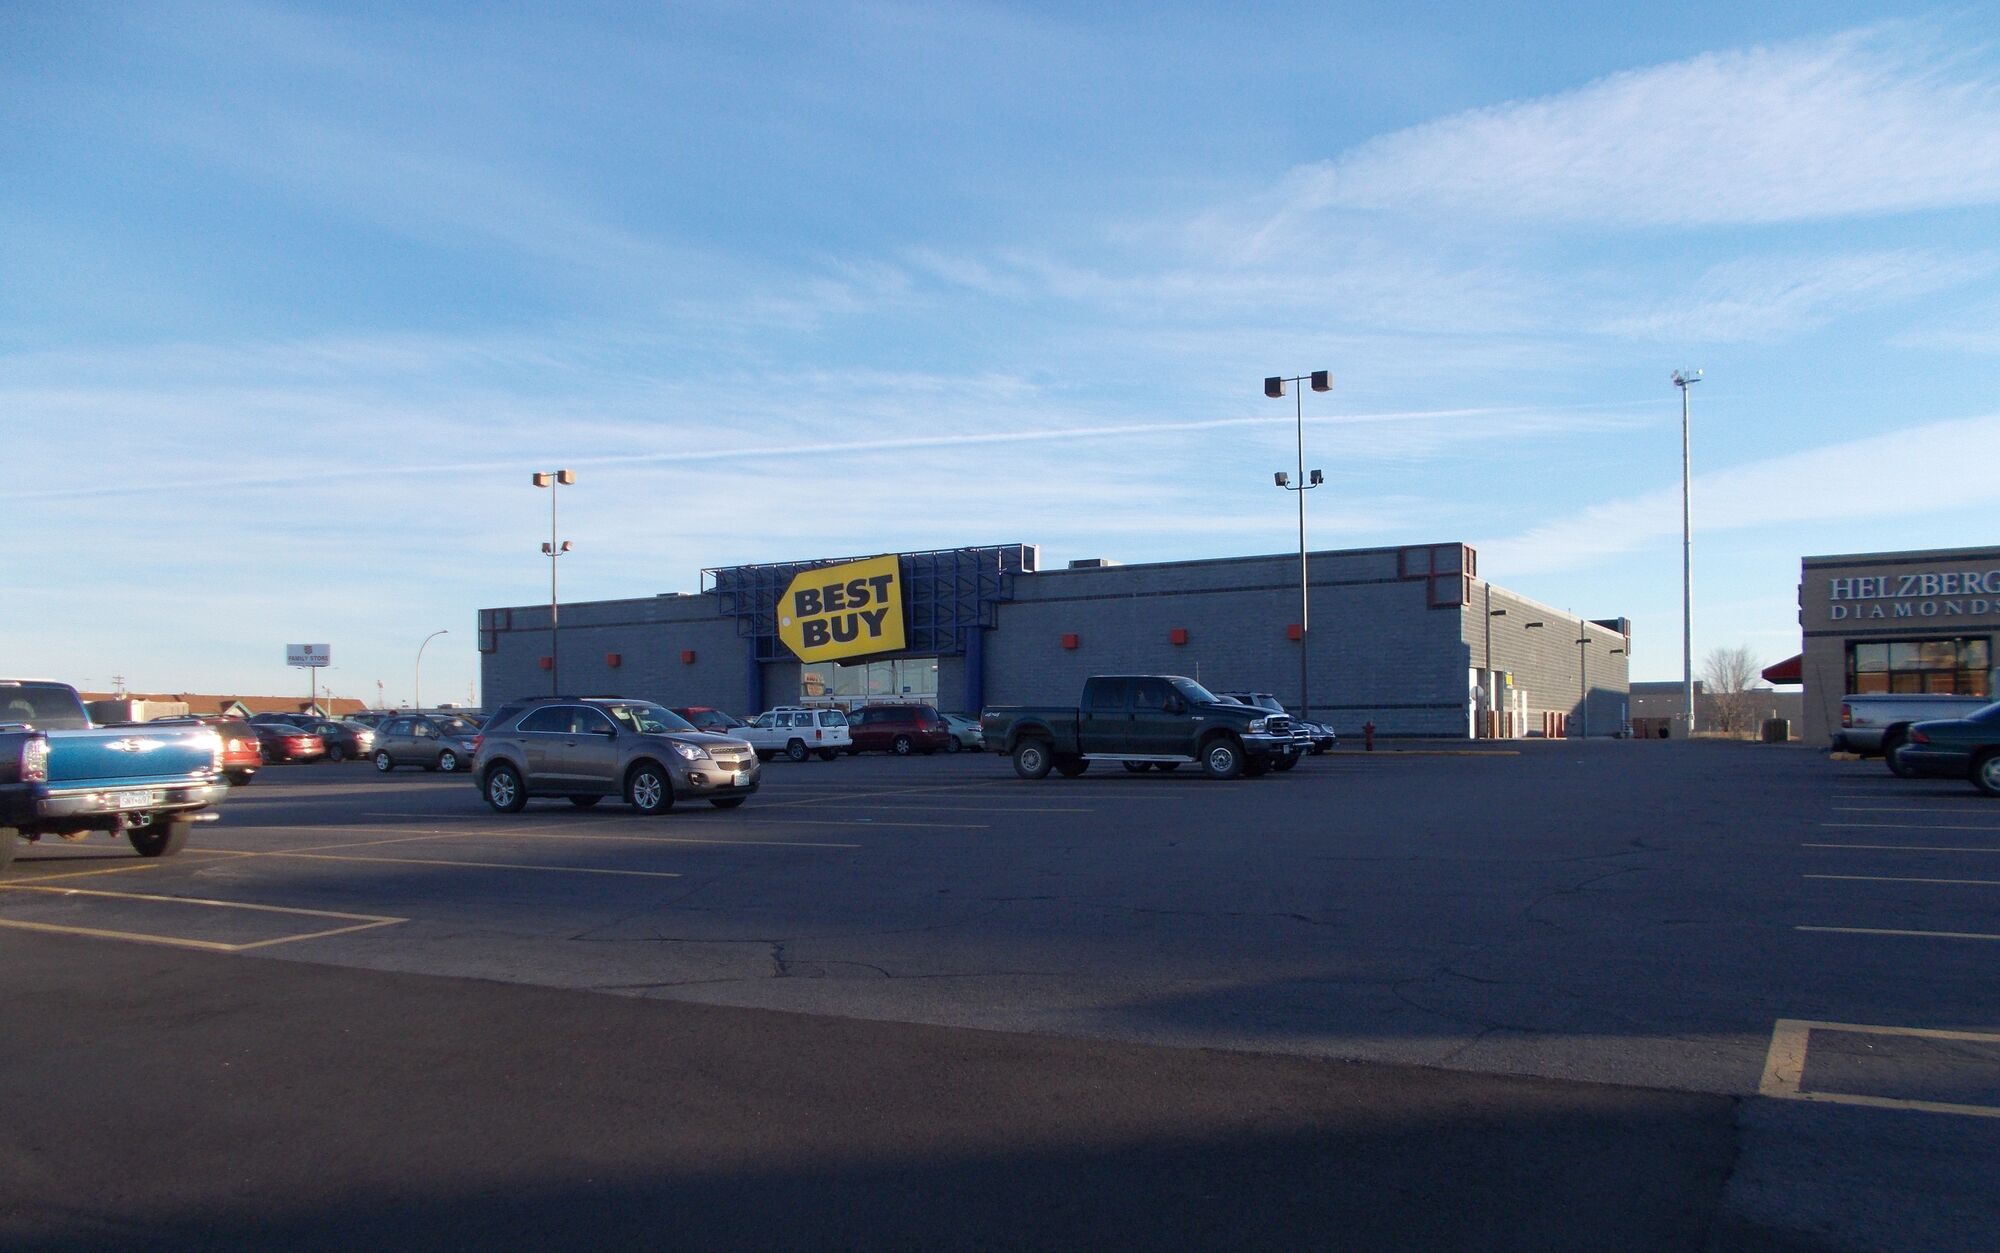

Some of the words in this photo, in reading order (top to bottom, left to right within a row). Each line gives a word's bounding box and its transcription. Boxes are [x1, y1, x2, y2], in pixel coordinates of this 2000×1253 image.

[794, 574, 893, 618] BEST
[1829, 570, 2000, 600] HELZBERG
[802, 607, 889, 648] BUY
